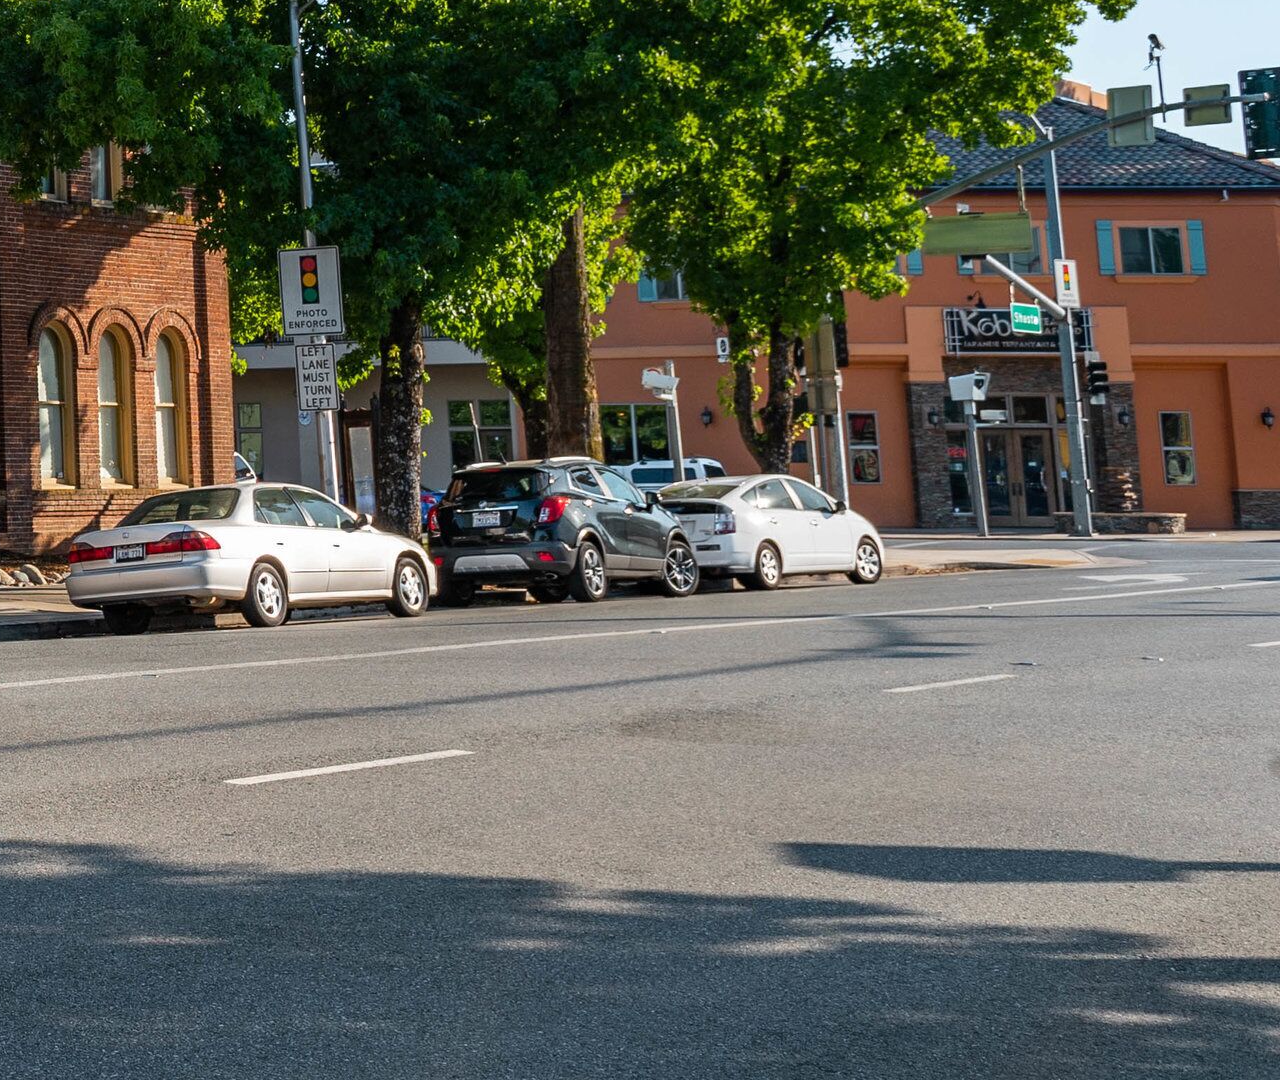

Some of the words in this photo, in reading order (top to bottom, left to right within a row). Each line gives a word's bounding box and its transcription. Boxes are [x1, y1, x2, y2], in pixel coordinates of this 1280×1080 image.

[296, 309, 328, 318] PHOTO
[1013, 311, 1039, 325] Shasta
[288, 320, 338, 329] ENFORCED
[959, 309, 1024, 337] Kob
[301, 346, 327, 357] LEFT
[302, 359, 330, 370] LANE
[303, 372, 330, 383] MUST
[304, 384, 332, 395] TURN
[306, 397, 332, 408] LEFT
